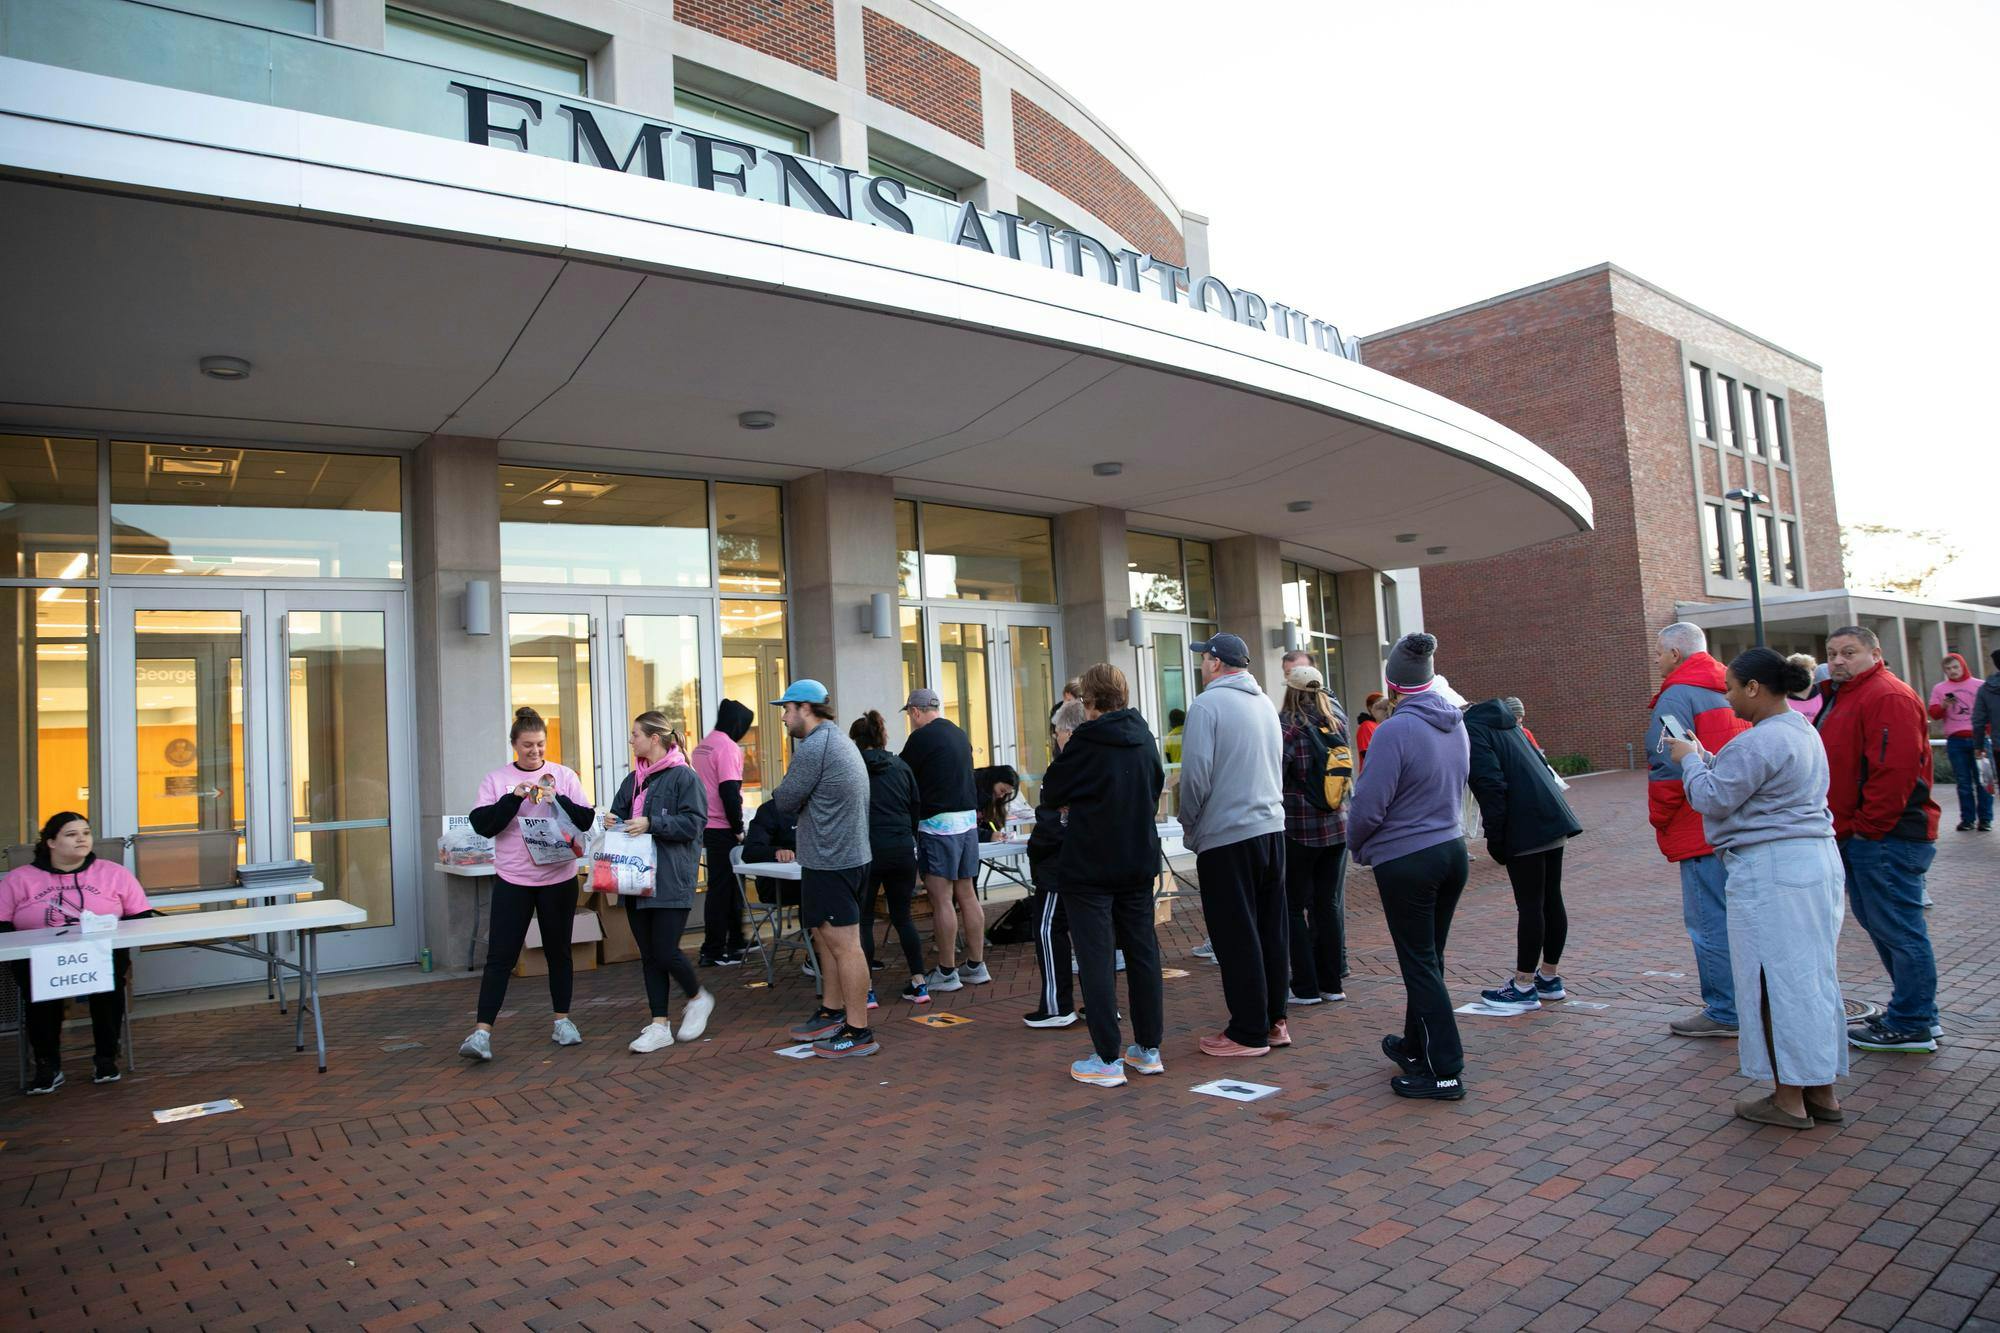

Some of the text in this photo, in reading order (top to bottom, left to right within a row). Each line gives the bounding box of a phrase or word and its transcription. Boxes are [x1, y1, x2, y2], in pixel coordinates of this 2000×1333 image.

[447, 80, 1362, 364] EMENS AUDITORIUM
[136, 667, 196, 684] George
[593, 852, 629, 865] GAMEDAY
[57, 952, 89, 967] BAG
[49, 971, 98, 988] CHECK
[834, 1040, 854, 1050] HOKA
[1436, 1079, 1459, 1088] HOKA
